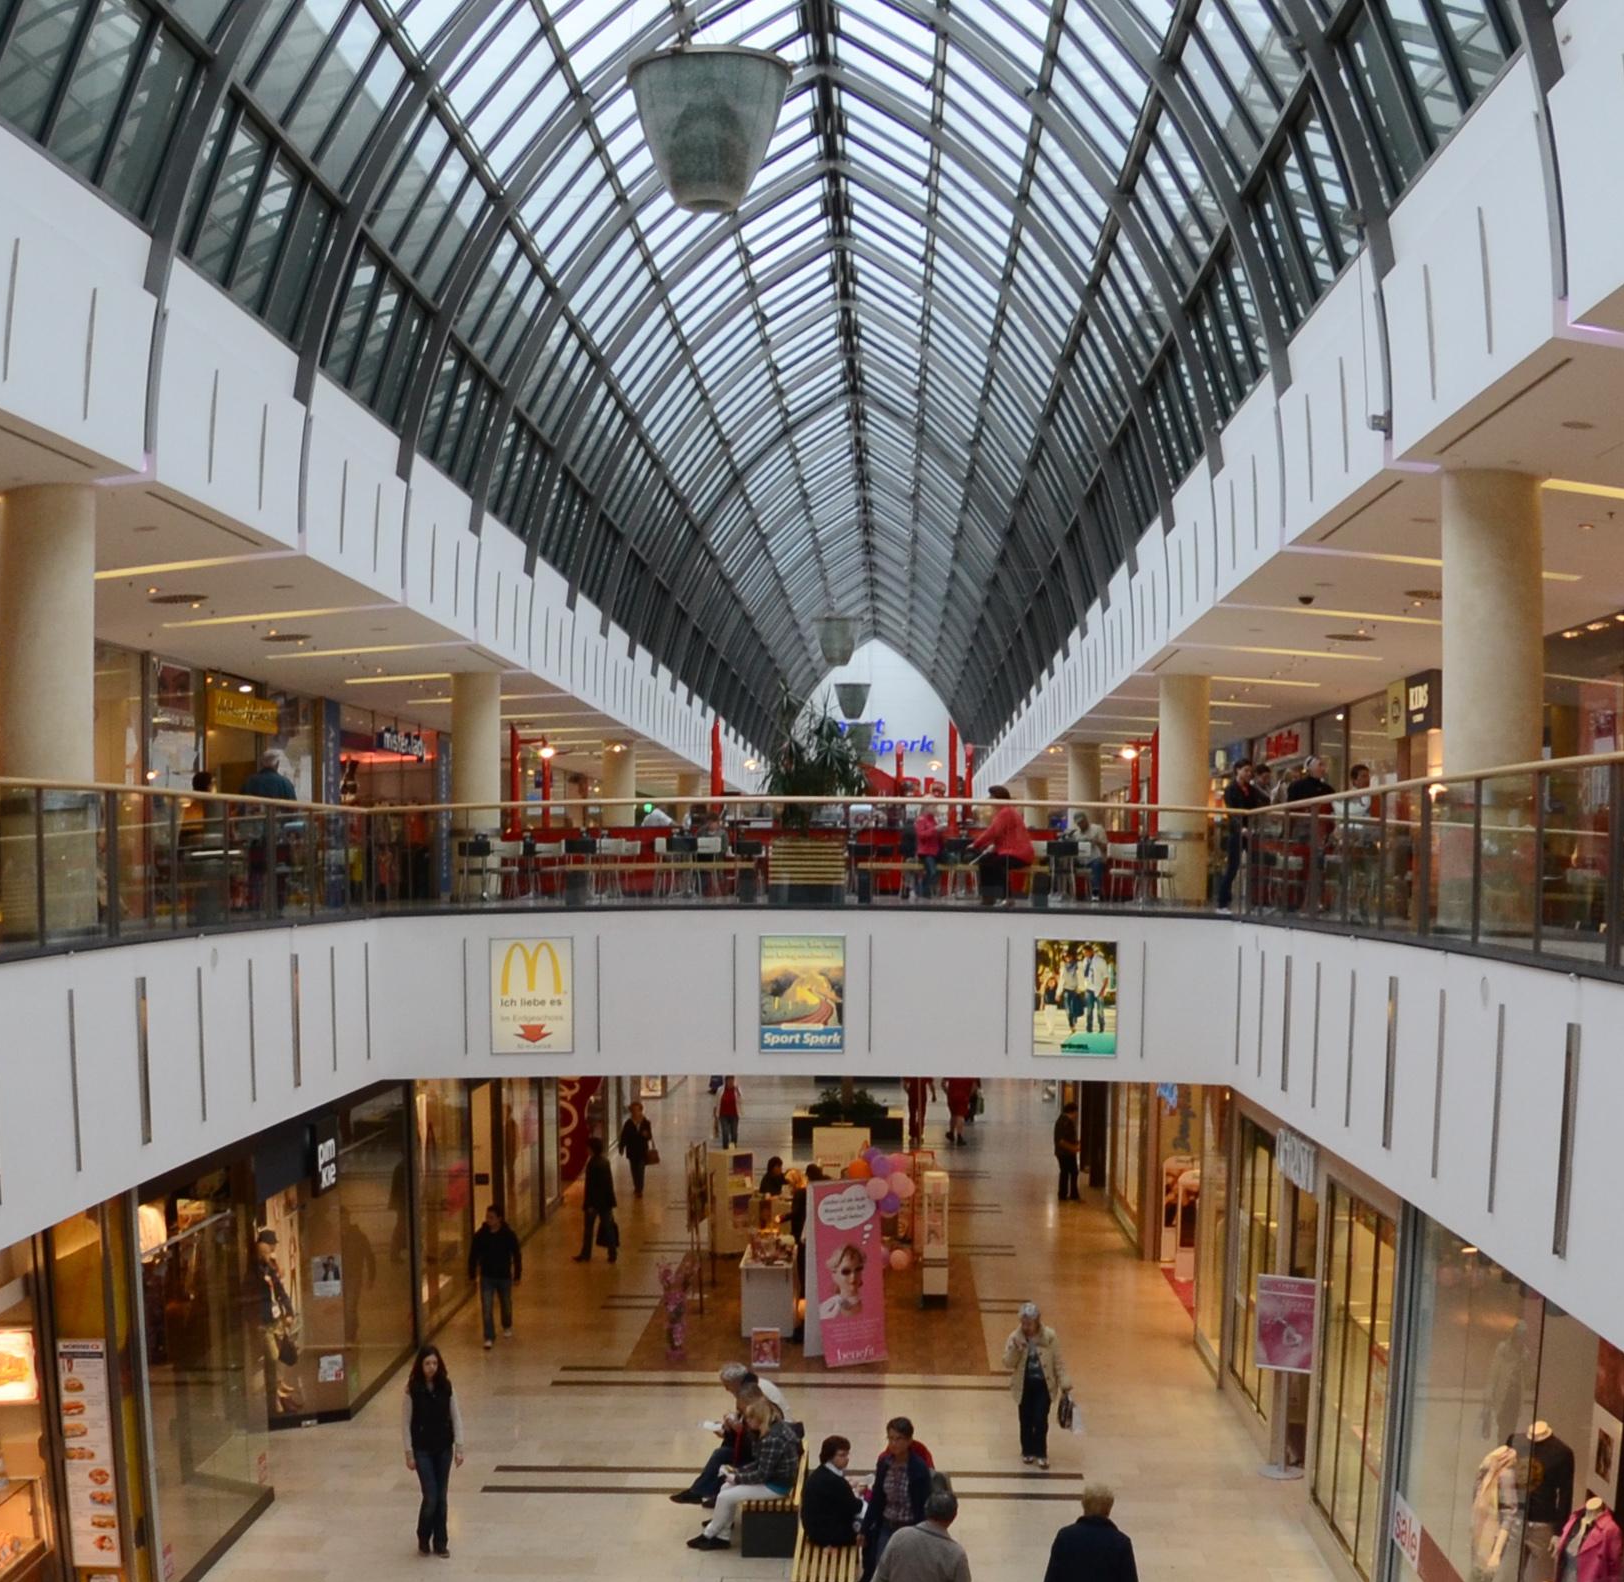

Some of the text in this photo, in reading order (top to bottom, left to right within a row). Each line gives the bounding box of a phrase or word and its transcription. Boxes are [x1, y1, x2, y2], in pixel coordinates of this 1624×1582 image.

[1409, 683, 1429, 711] KIDS
[500, 998, 562, 1008] Ich liebe es
[763, 1031, 841, 1046] Sport Sperk
[1395, 1511, 1418, 1561] sale
